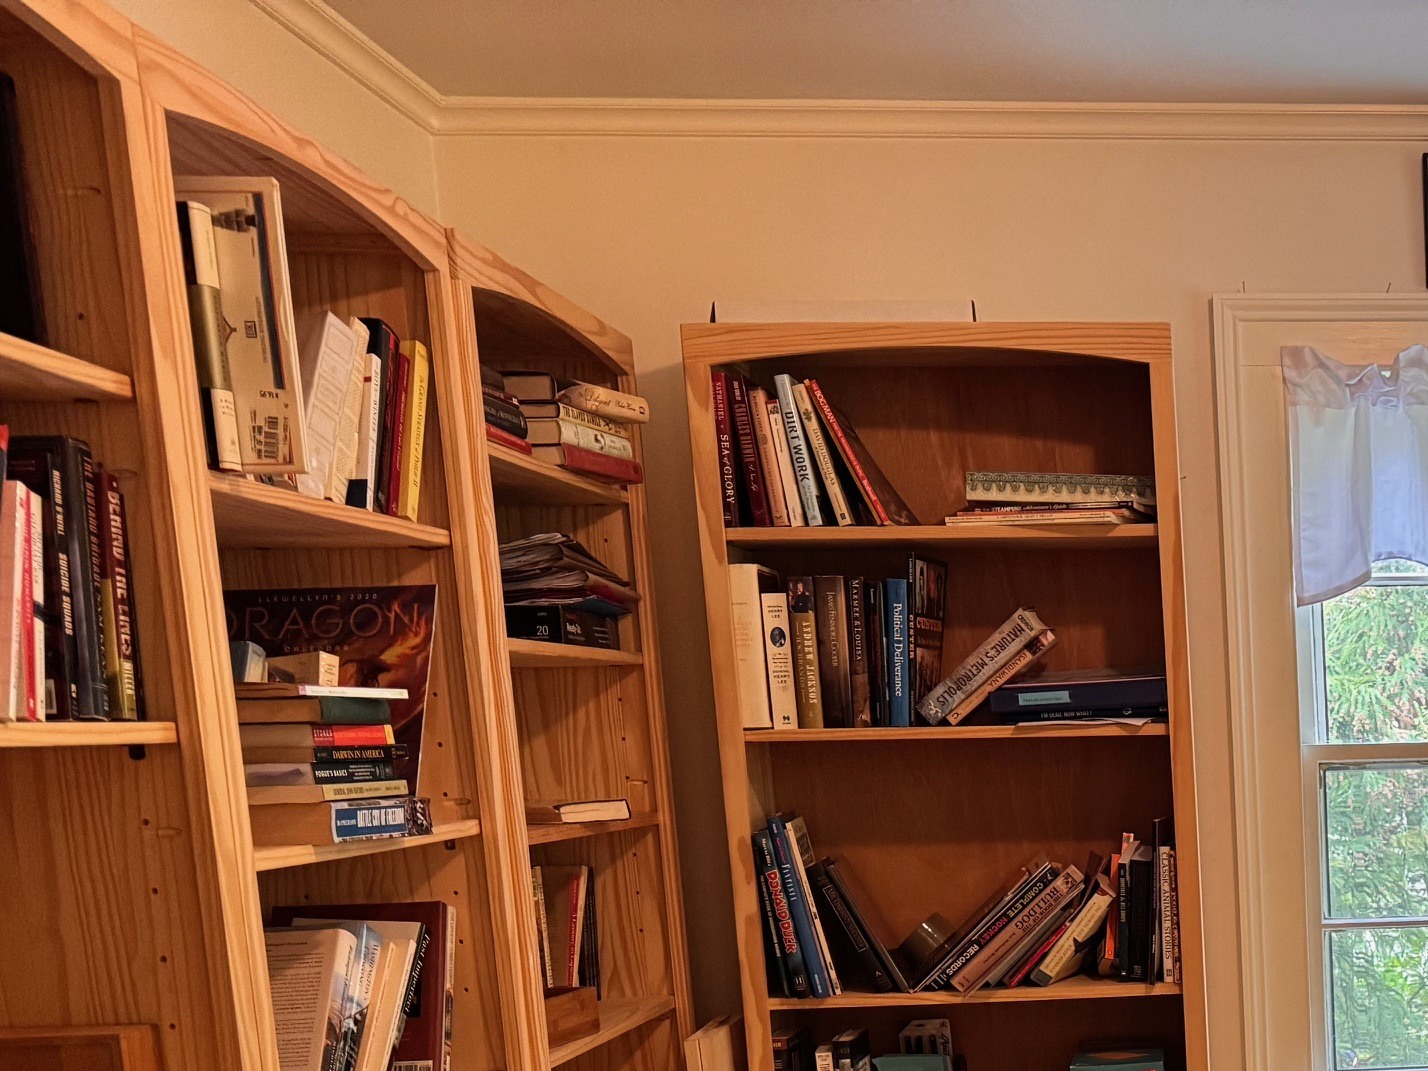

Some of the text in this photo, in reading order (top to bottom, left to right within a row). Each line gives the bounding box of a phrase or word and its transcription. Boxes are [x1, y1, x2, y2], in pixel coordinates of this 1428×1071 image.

[720, 434, 730, 455] SEA
[785, 411, 810, 483] DIRT WORK
[812, 428, 825, 454] DAVID
[819, 454, 837, 486] DOUGLAS
[723, 466, 735, 504] GLORY
[58, 552, 70, 592] SUICIDE
[63, 595, 73, 635] SQUADS
[350, 593, 378, 601] 2020
[536, 625, 549, 636] 20
[854, 627, 862, 661] LOUISA
[893, 603, 903, 698] Political Deliverance
[802, 621, 818, 705] ANDREW JACKSON
[936, 621, 1026, 707] NATURE'S METROPOLIS
[987, 651, 1028, 688] ISANDLWANA
[332, 749, 354, 759] DARWIN
[361, 749, 385, 759] AMERICA
[765, 869, 790, 921] DONALD
[779, 919, 798, 954] DUCK
[1014, 885, 1060, 931] BULLDOG
[1161, 851, 1172, 960] CLASSIC ANIMAL STORIES
[946, 882, 1044, 977] COMPLETE HOCKEY RECORDS
[405, 933, 431, 1014] Past Imperfect
